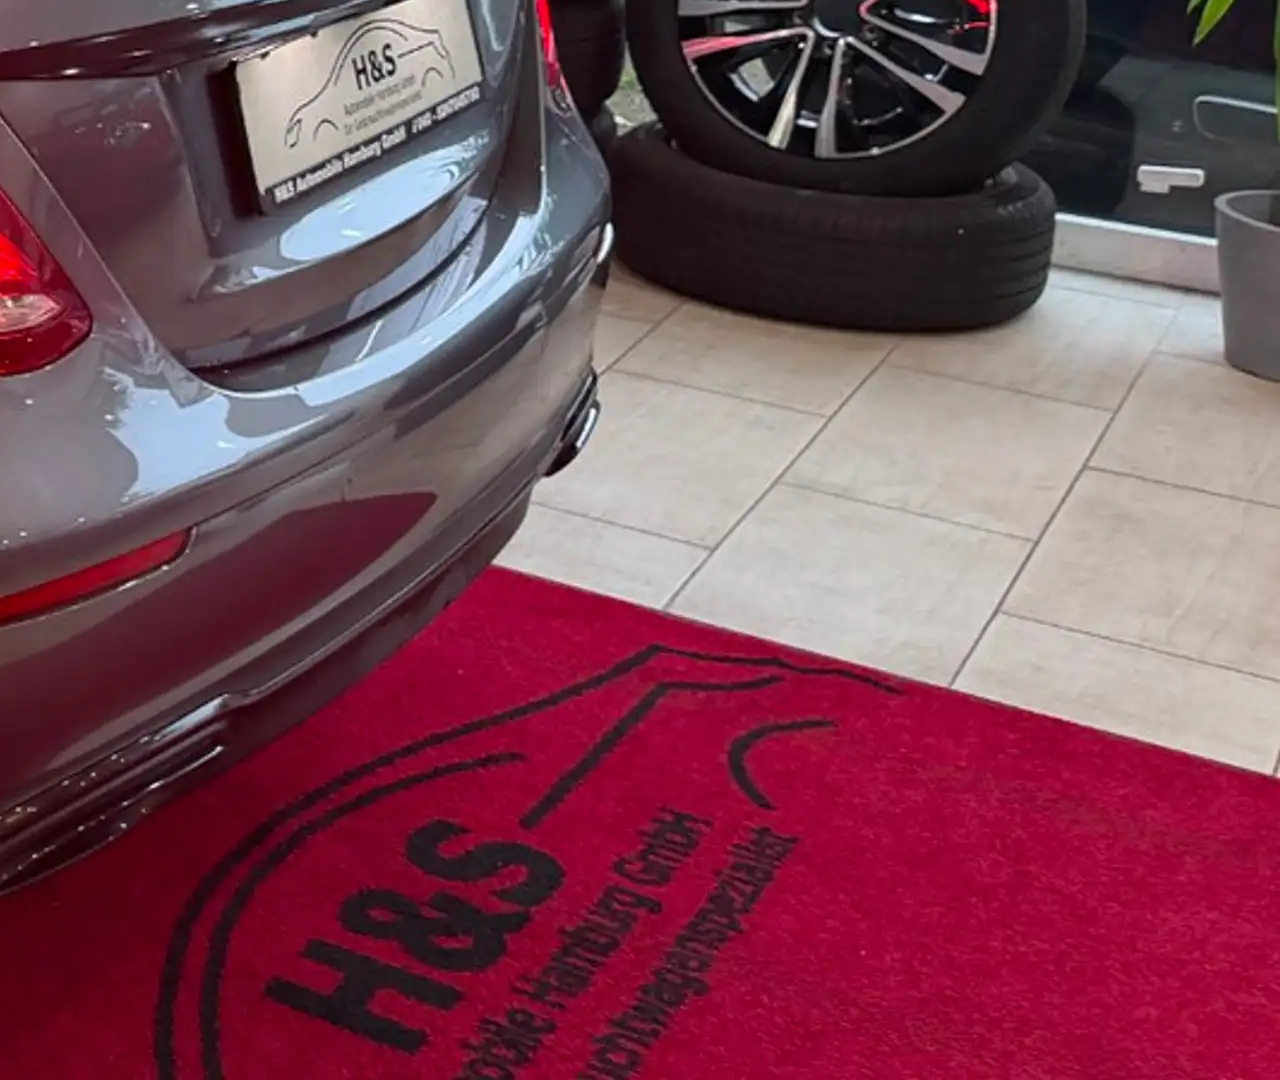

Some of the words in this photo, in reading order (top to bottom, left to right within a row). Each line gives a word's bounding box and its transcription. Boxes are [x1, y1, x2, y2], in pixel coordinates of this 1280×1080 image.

[351, 43, 397, 91] H&S
[263, 816, 567, 1055] H&S
[511, 884, 663, 1010] Hamburg
